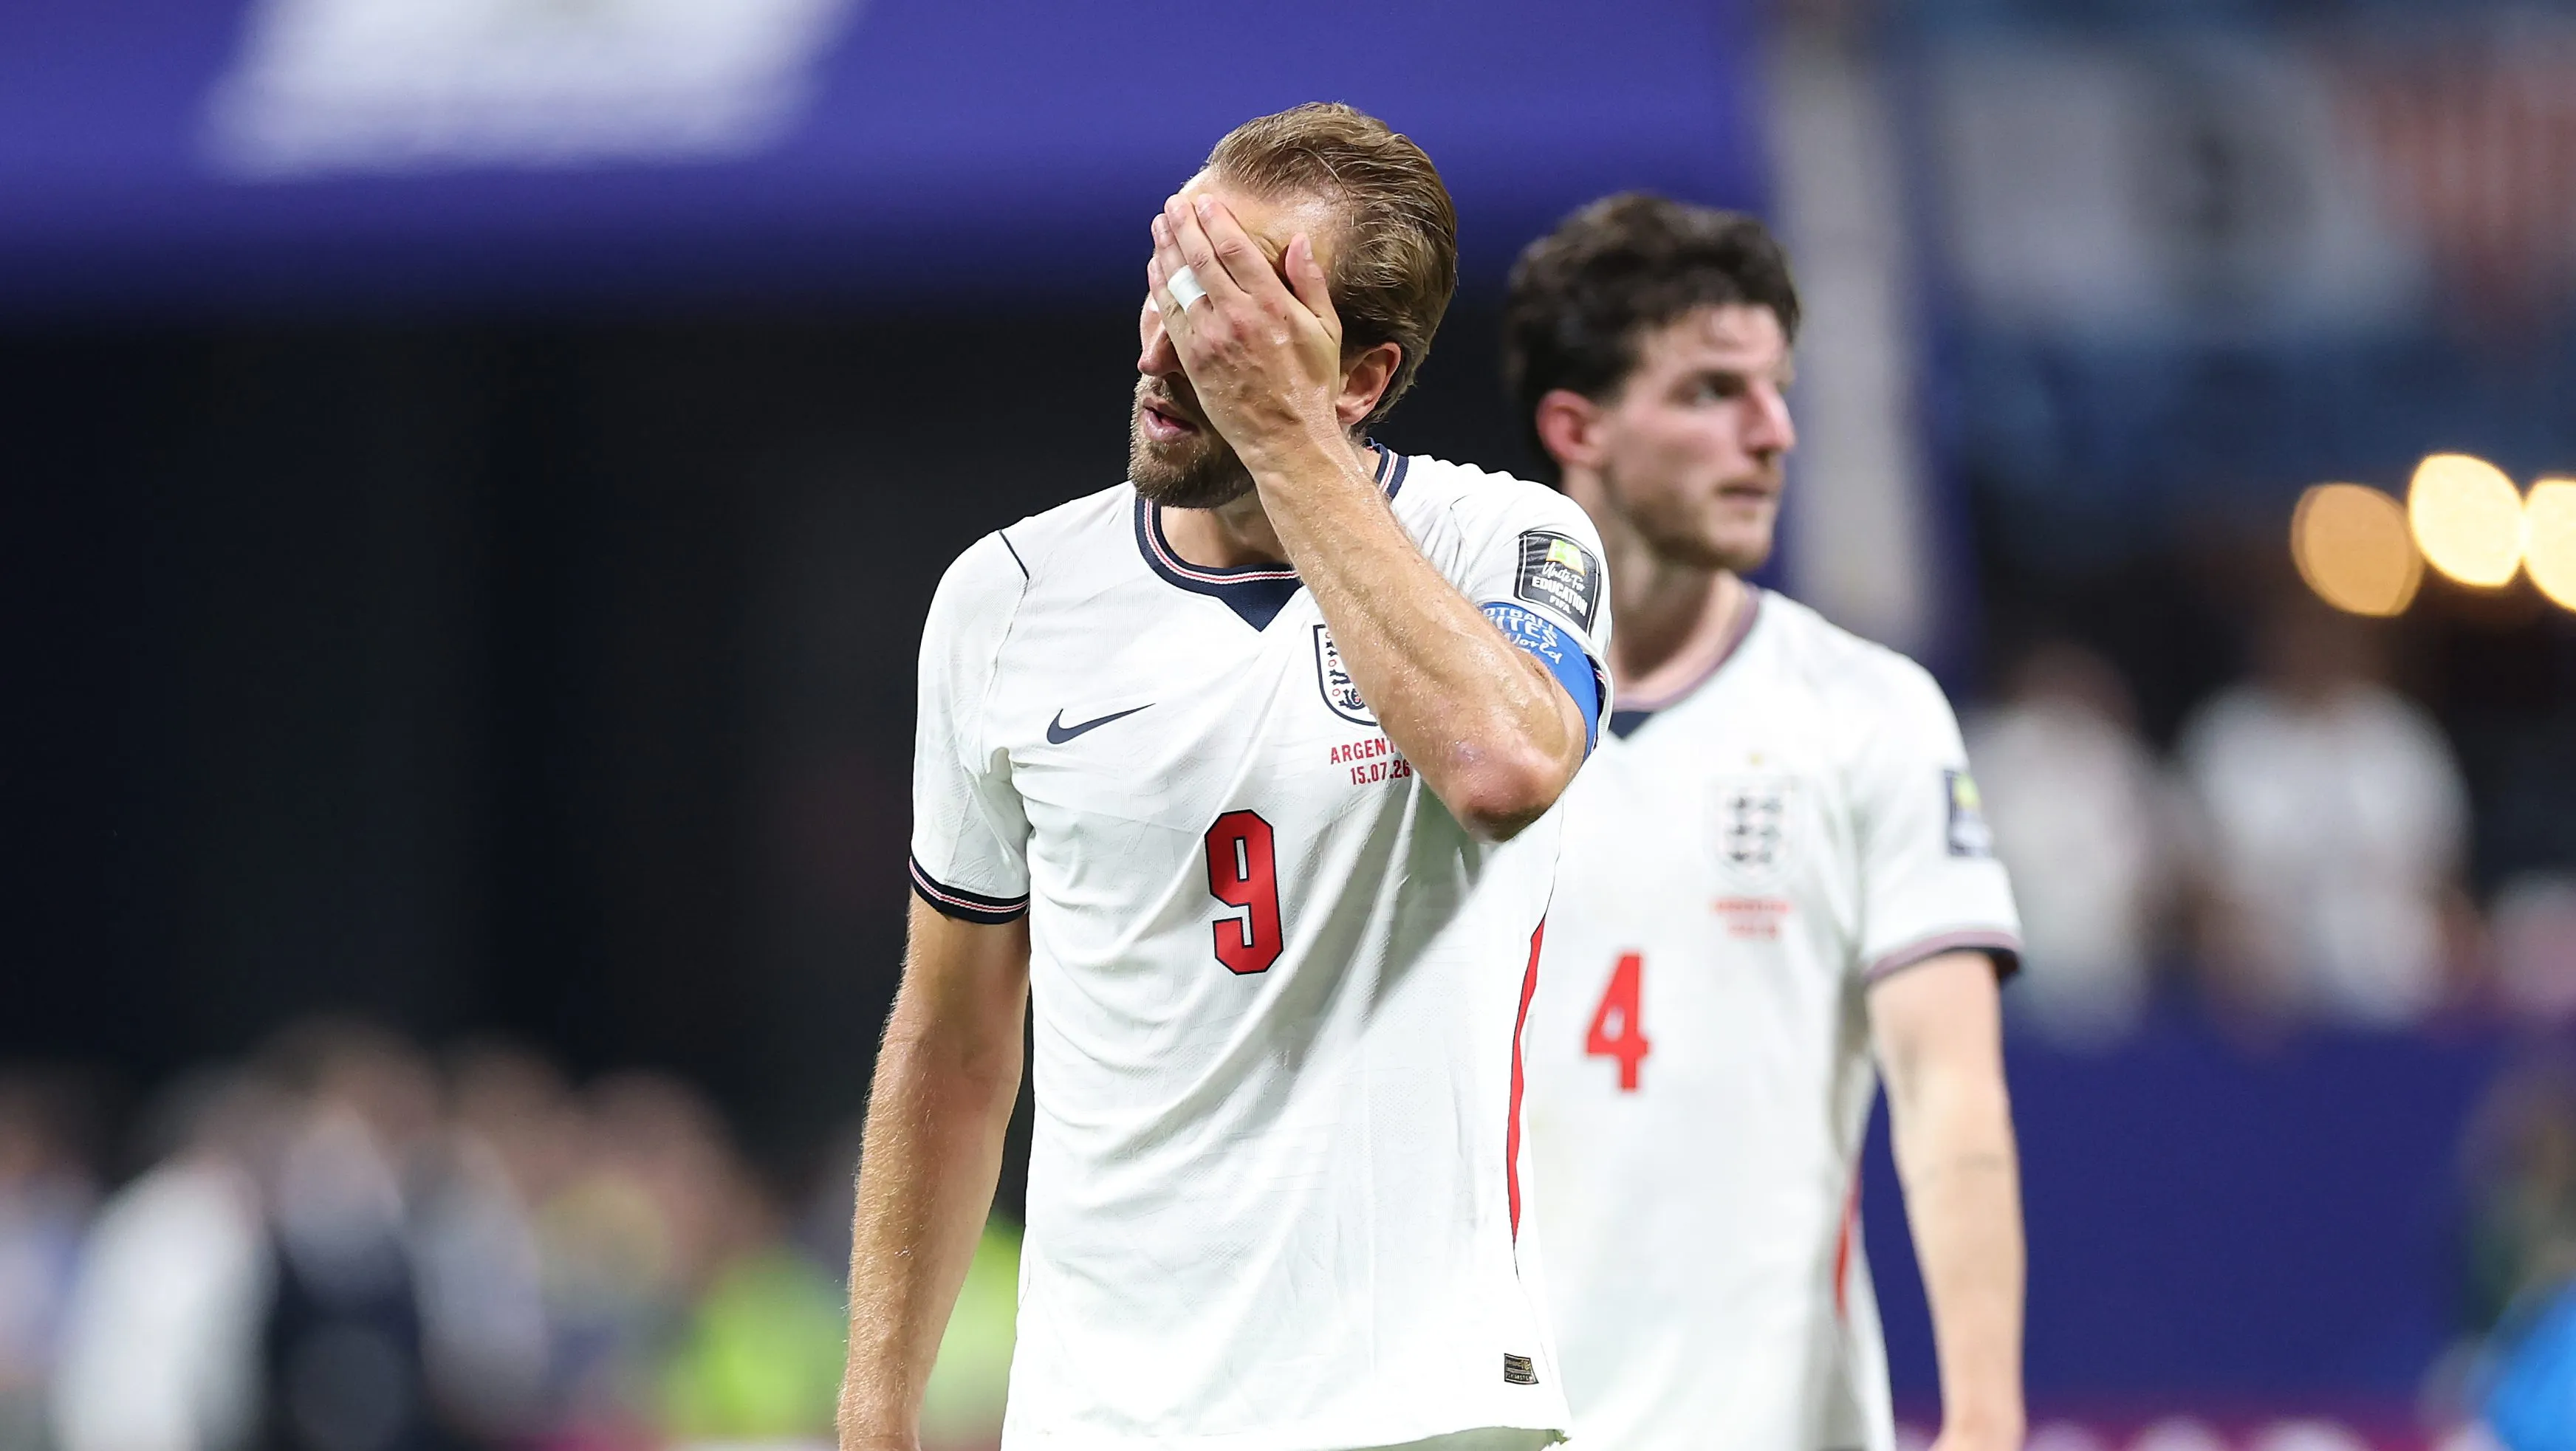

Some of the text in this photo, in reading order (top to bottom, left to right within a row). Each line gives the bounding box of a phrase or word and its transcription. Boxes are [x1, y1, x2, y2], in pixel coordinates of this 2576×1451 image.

[1542, 561, 1586, 591] Unite For
[1532, 576, 1588, 617] EDUCATION
[1549, 595, 1572, 614] FIFA
[1350, 758, 1411, 786] 15.07.26
[1204, 809, 1284, 976] 9
[1584, 953, 1652, 1092] 4
